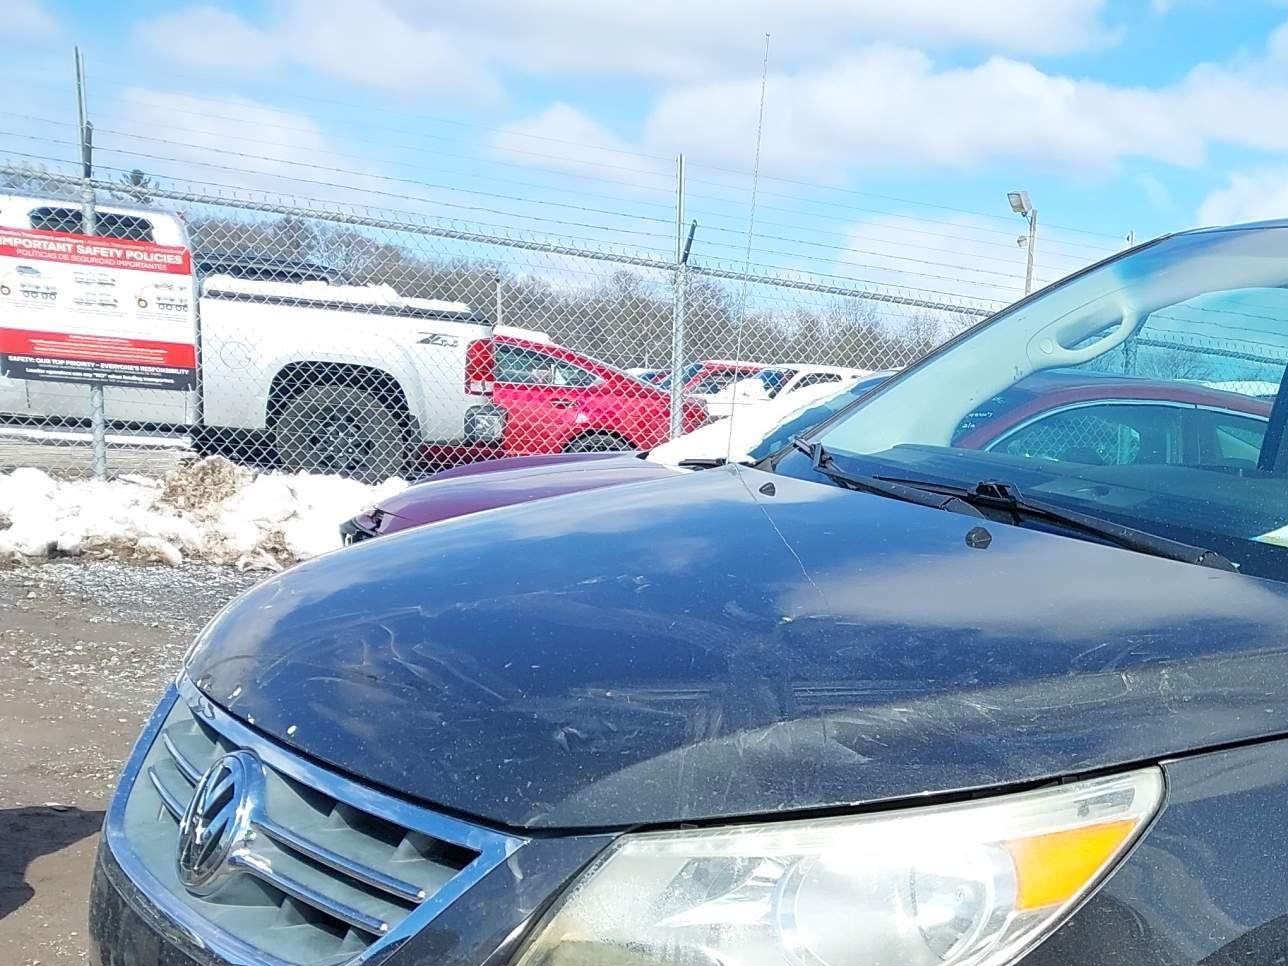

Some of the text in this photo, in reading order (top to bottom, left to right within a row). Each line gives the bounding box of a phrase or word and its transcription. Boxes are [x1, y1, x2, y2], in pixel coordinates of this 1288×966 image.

[0, 235, 73, 252] IMPORTANT
[76, 244, 123, 258] SAFETY
[125, 249, 183, 265] POLICIES
[59, 253, 69, 261] DE
[70, 253, 115, 265] SEGURIDAD
[116, 260, 167, 271] IMPORTANTES
